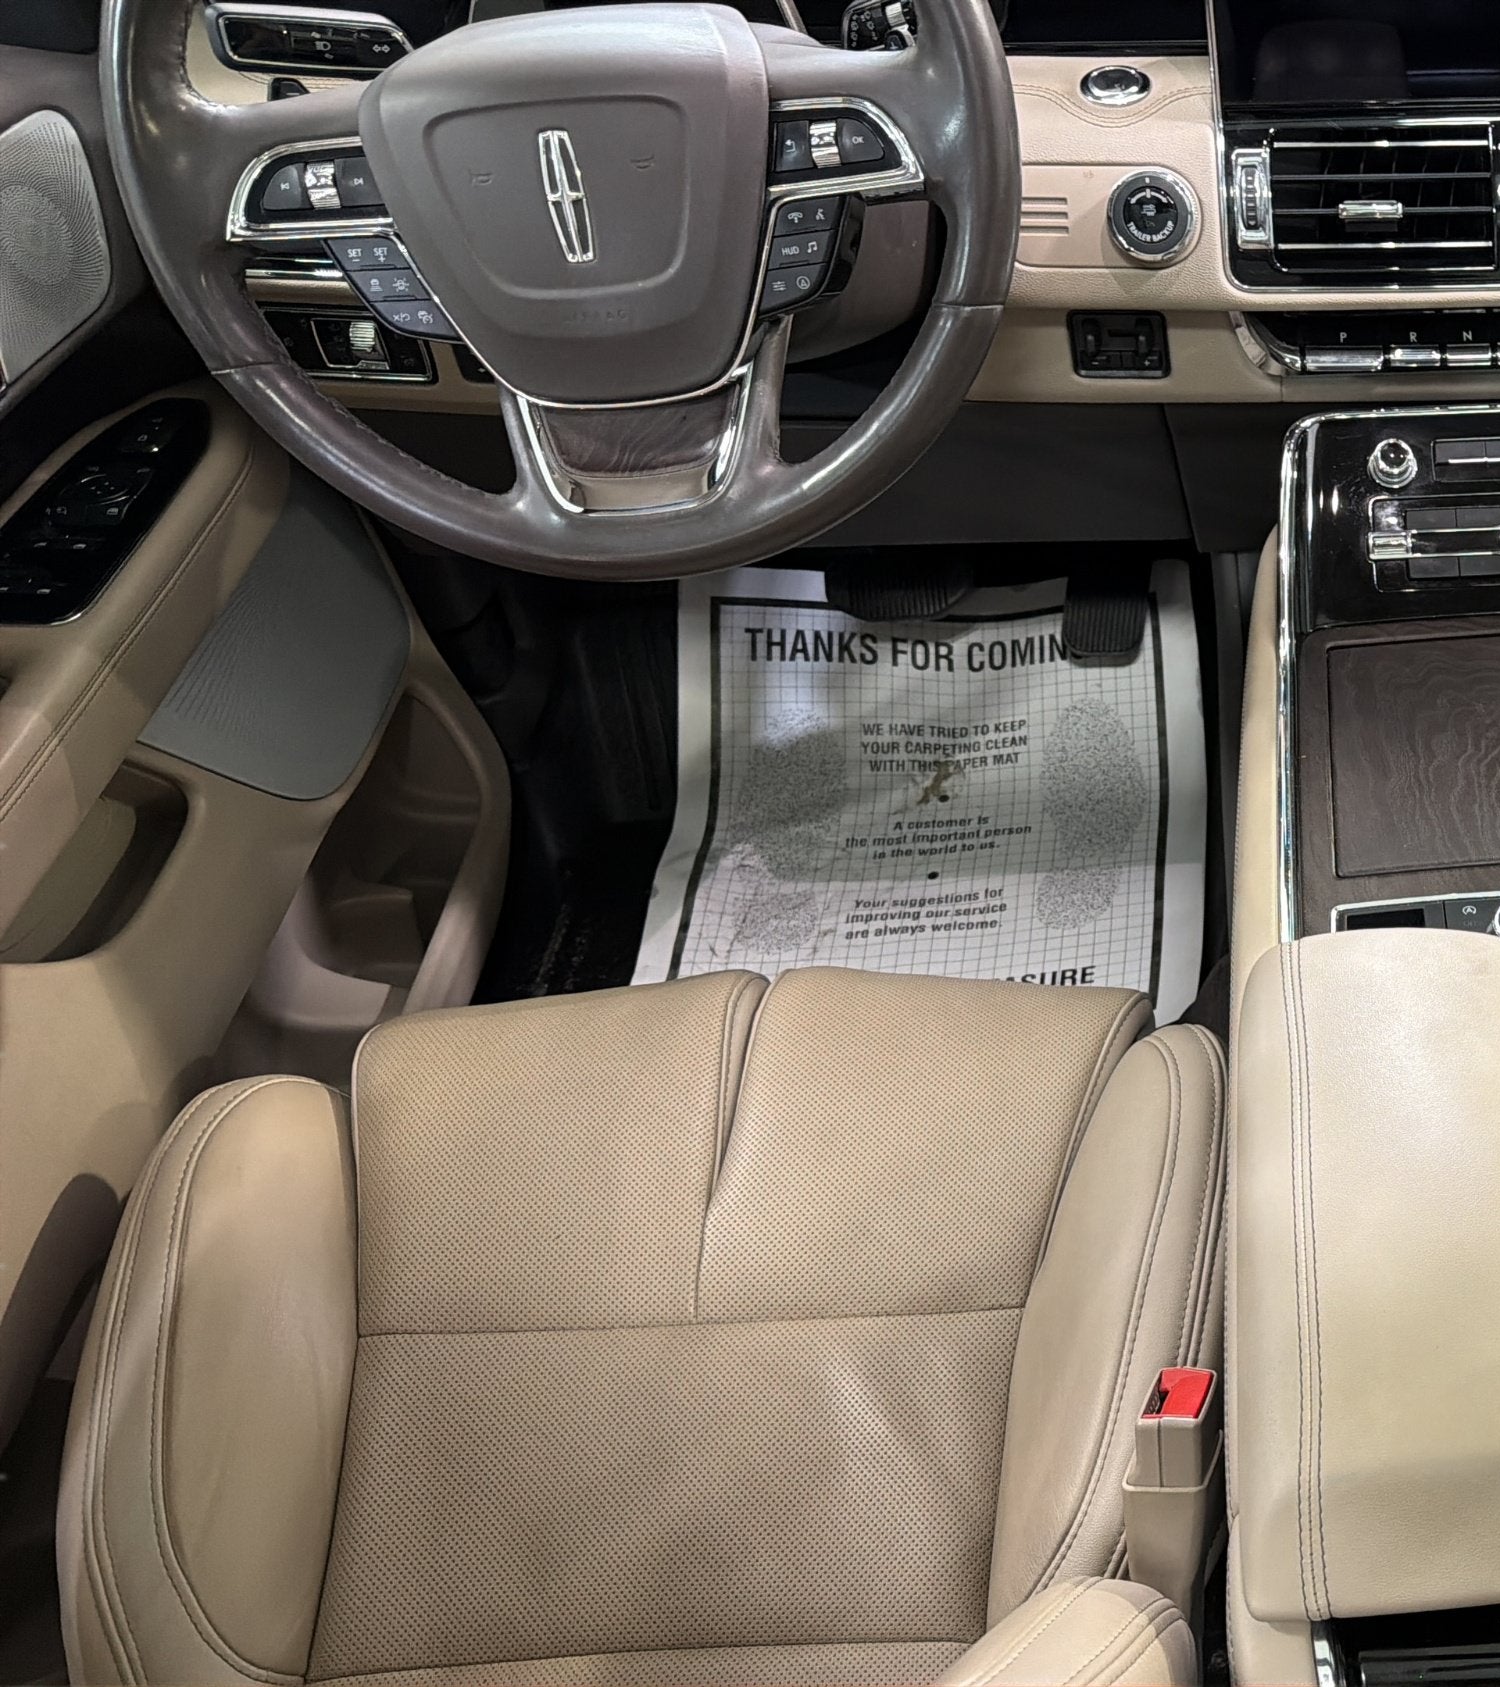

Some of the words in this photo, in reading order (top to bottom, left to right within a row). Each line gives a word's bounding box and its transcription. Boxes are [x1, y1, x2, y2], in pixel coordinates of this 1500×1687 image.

[852, 135, 865, 144] OK
[1127, 221, 1152, 242] TRAILER
[1153, 221, 1175, 242] BACKUP
[347, 248, 362, 257] SET
[373, 247, 388, 256] SET
[782, 246, 800, 256] HUD
[1340, 332, 1347, 342] P
[1410, 332, 1417, 342] R
[1463, 331, 1472, 341] N
[744, 627, 879, 665] THANKS
[891, 636, 954, 672] FOR
[967, 633, 1082, 672] COMIN
[863, 723, 884, 736] WE
[889, 723, 925, 737] HAVE
[930, 725, 969, 739] TRIED
[973, 724, 990, 736] TO
[994, 719, 1027, 734] KEEP
[861, 741, 900, 754] YOUR
[905, 741, 982, 756] CARPETING
[985, 735, 1028, 751] CLEAN
[869, 760, 906, 772] WITH
[993, 752, 1021, 766] MAT
[893, 821, 903, 830] A
[907, 818, 973, 830] customer
[845, 837, 868, 848] the
[872, 834, 907, 846] most
[912, 828, 981, 844] important
[984, 825, 1032, 839] person
[872, 850, 886, 860] in
[891, 847, 912, 858] the
[918, 843, 957, 856] world
[961, 842, 975, 852] to
[980, 840, 1001, 850] us.
[854, 899, 887, 909] Your
[891, 891, 980, 908] suggestions
[984, 888, 1004, 899] for
[845, 909, 921, 924] improving
[925, 909, 950, 918] our
[954, 902, 1007, 918] service
[845, 930, 869, 940] are
[874, 924, 926, 936] always
[931, 918, 1003, 932] welcome.
